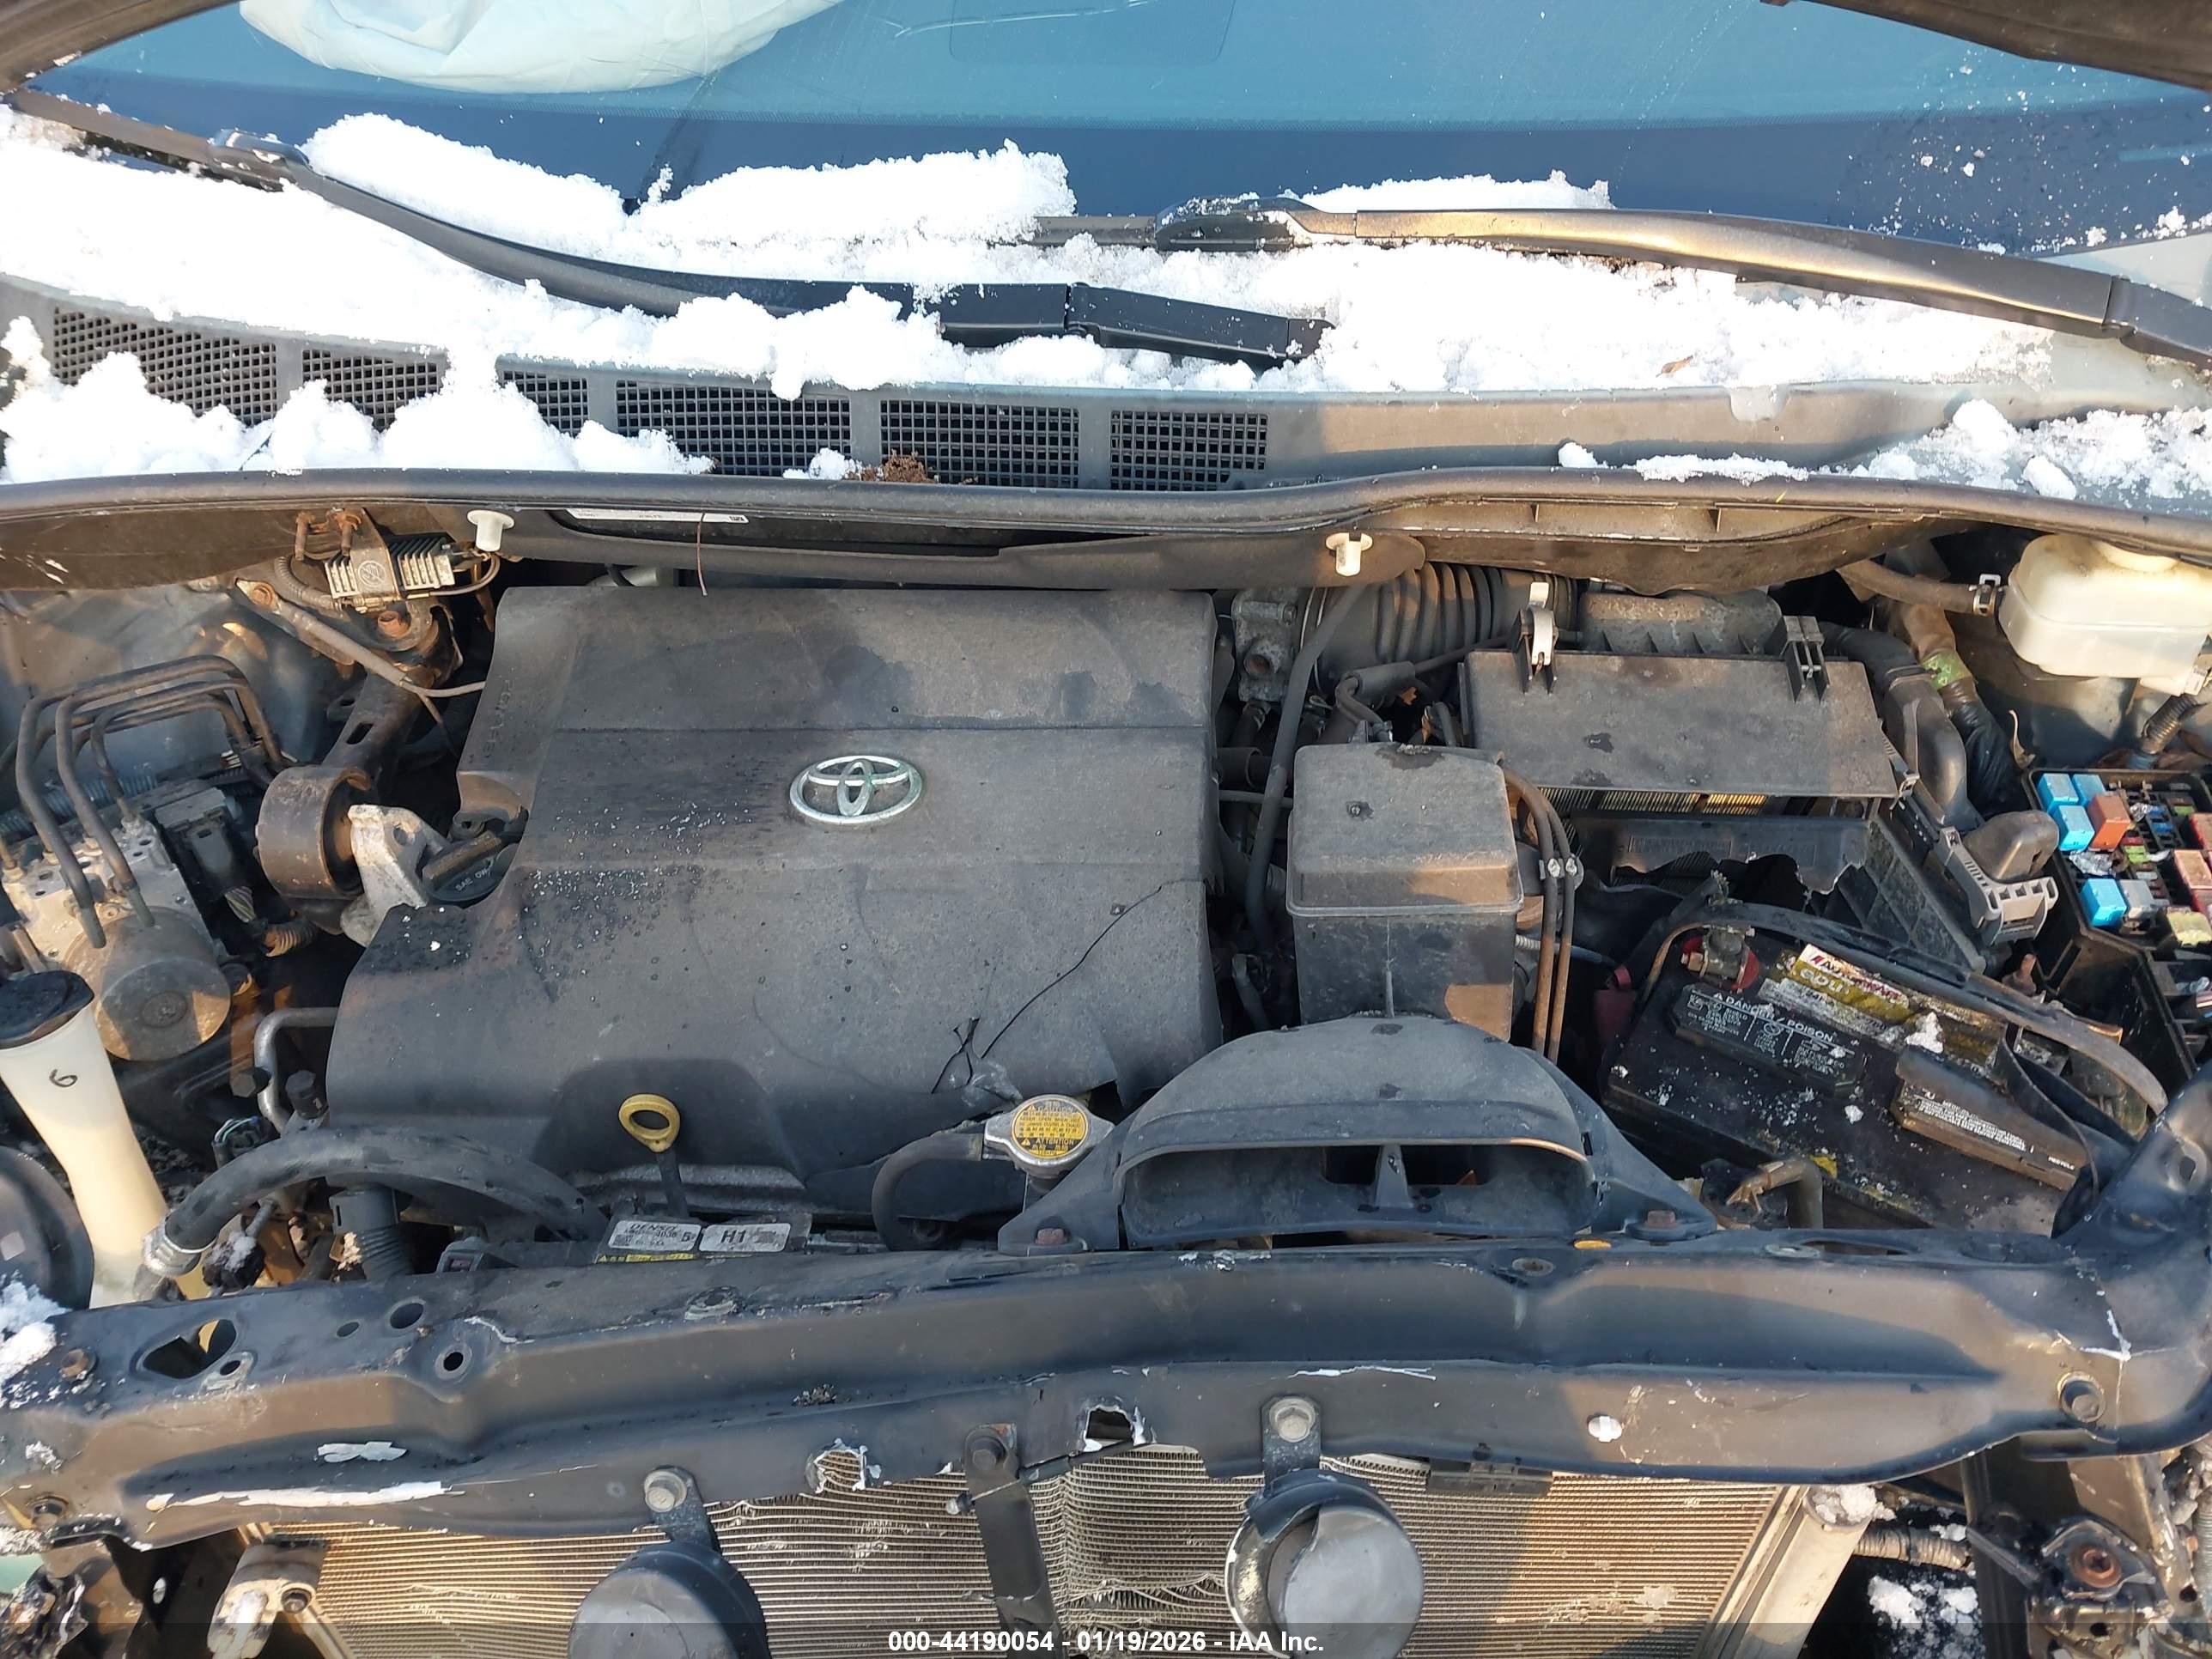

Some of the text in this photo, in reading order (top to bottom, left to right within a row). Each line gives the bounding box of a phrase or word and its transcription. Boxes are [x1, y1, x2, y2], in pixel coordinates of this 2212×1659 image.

[1787, 1019, 1834, 1042] POISON
[49, 1069, 78, 1087] 6
[721, 1230, 746, 1243] H1
